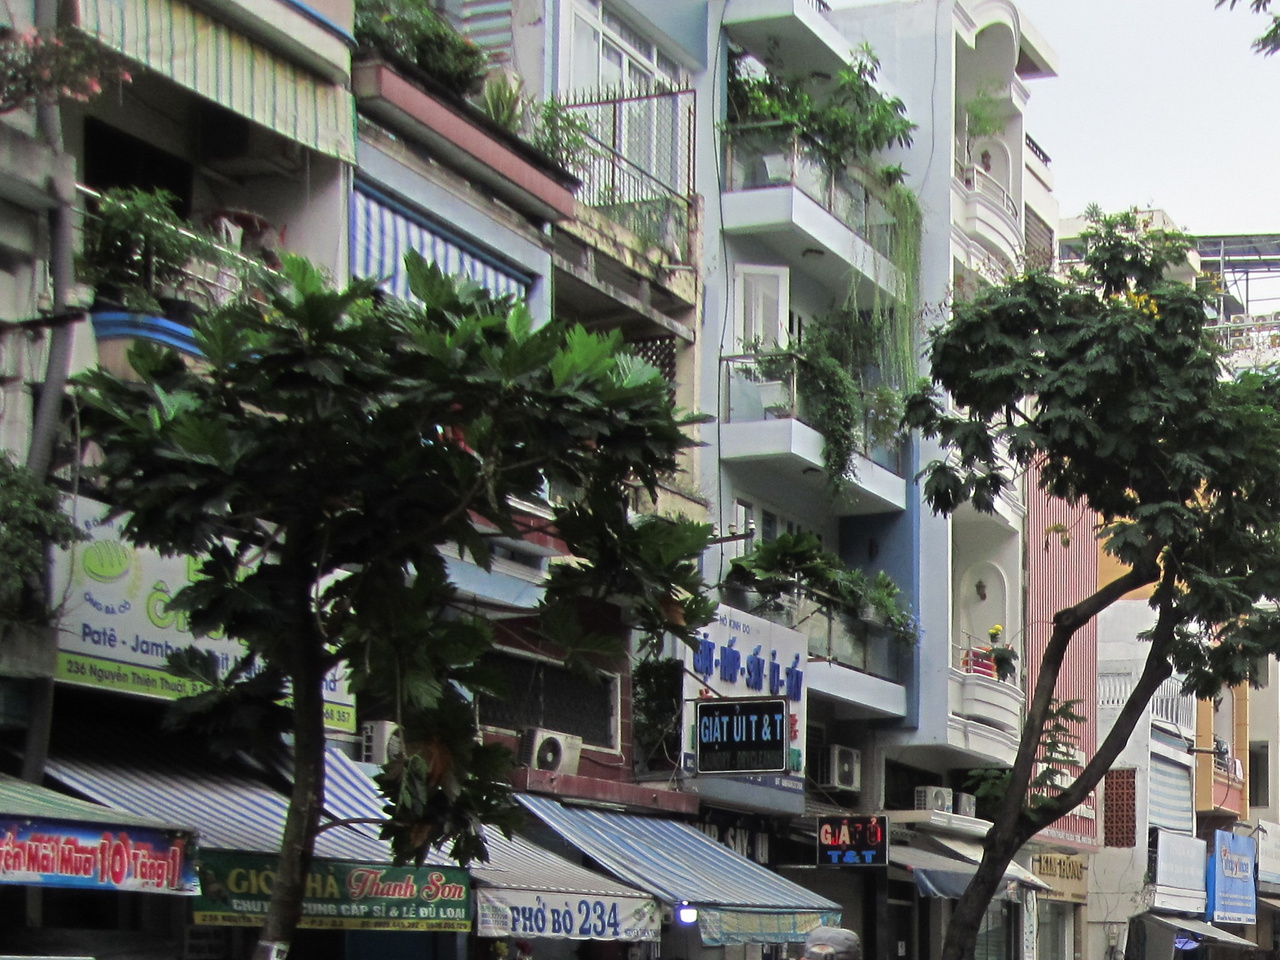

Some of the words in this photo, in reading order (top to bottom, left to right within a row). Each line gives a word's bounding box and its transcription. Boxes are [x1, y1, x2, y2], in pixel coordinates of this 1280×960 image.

[82, 623, 117, 648] Patê
[66, 659, 86, 676] 236
[701, 710, 729, 750] GIẶT
[733, 705, 746, 741] ỦI
[750, 715, 757, 741] T
[762, 714, 771, 741] &
[774, 714, 782, 740] T
[58, 844, 95, 877] Mua
[99, 839, 128, 885] 10
[131, 849, 168, 889] Tặng
[827, 850, 877, 864] T&T
[305, 866, 340, 898] HẢ
[348, 867, 417, 900] Thanh
[420, 872, 465, 902] Sơn
[389, 906, 399, 917] &
[440, 907, 465, 921] LOẠI
[509, 895, 546, 933] PHỞ
[551, 901, 573, 934] BÒ
[578, 900, 620, 936] 234
